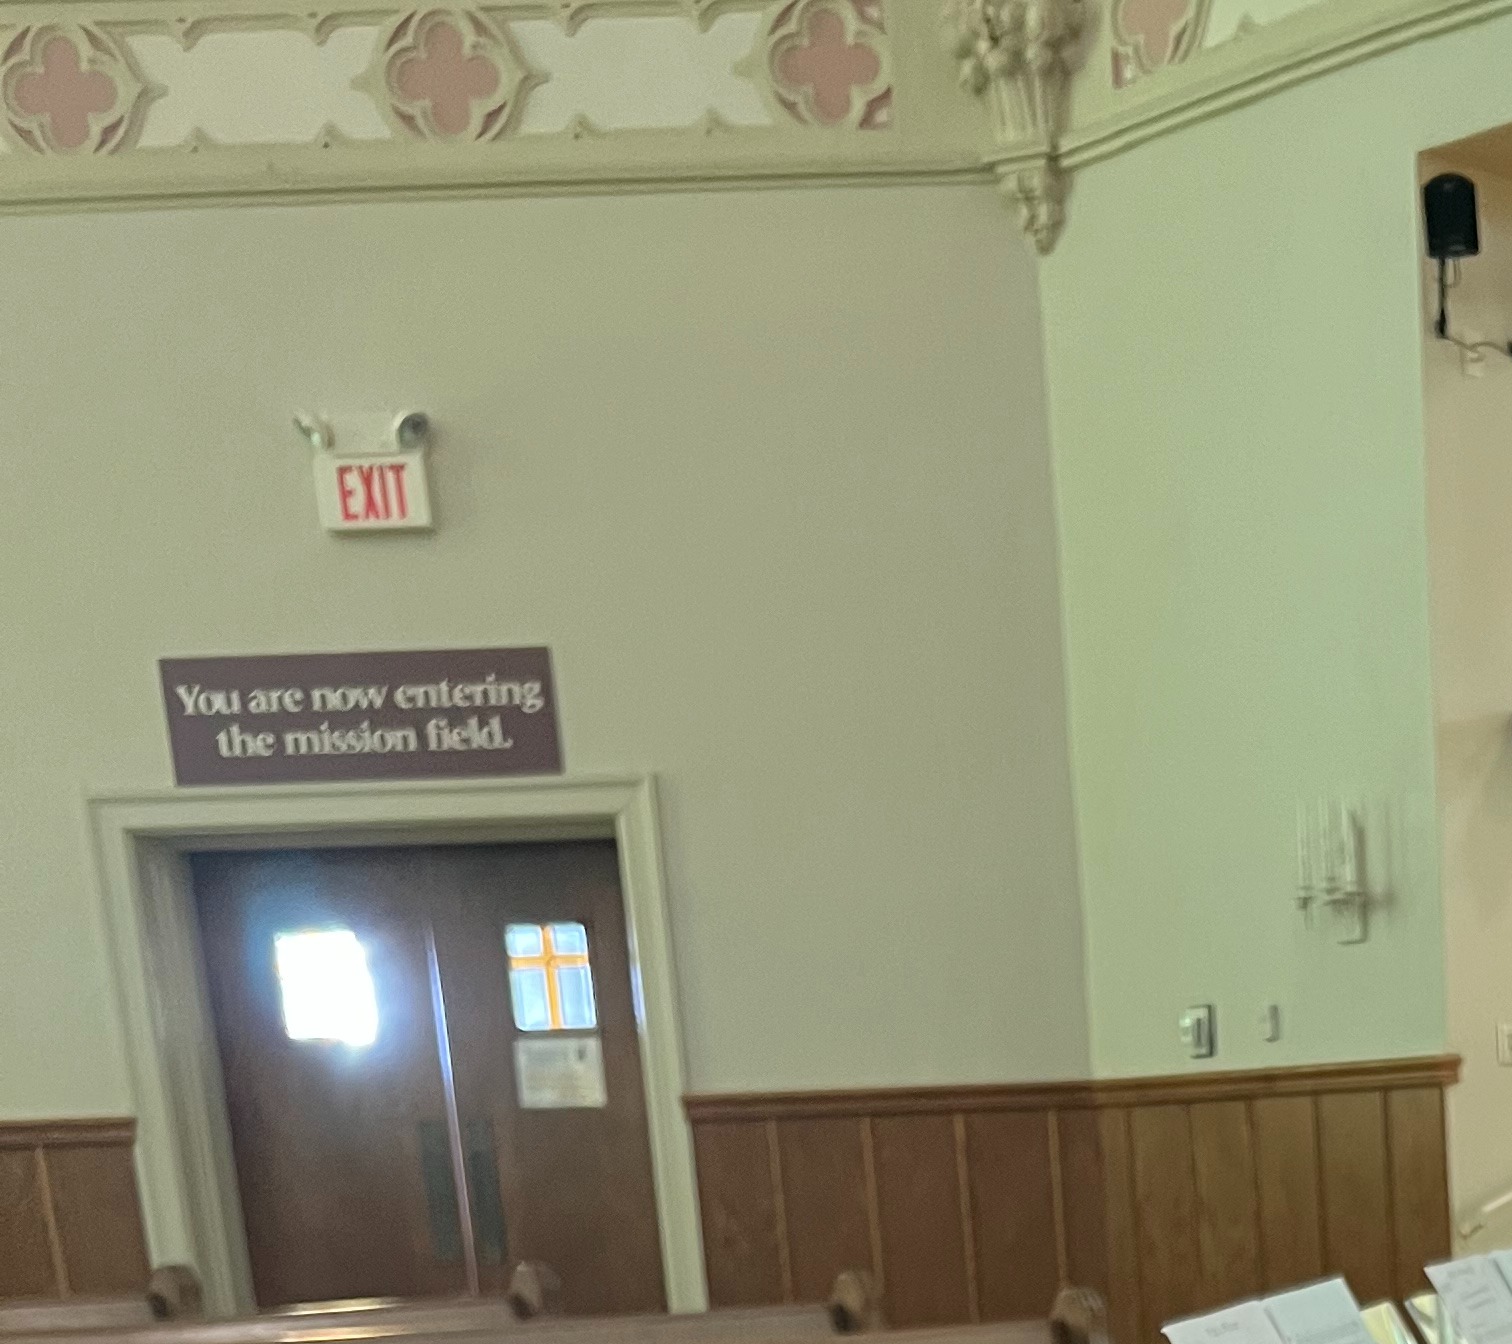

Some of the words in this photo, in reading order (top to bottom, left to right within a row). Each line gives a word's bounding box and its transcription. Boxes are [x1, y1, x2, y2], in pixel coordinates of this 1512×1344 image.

[337, 463, 409, 522] EXIT
[175, 684, 240, 716] You
[248, 686, 304, 713] are
[311, 684, 389, 711] now
[394, 673, 544, 713] entering
[216, 723, 274, 758] the
[283, 721, 417, 756] mission
[426, 715, 513, 752] field.
